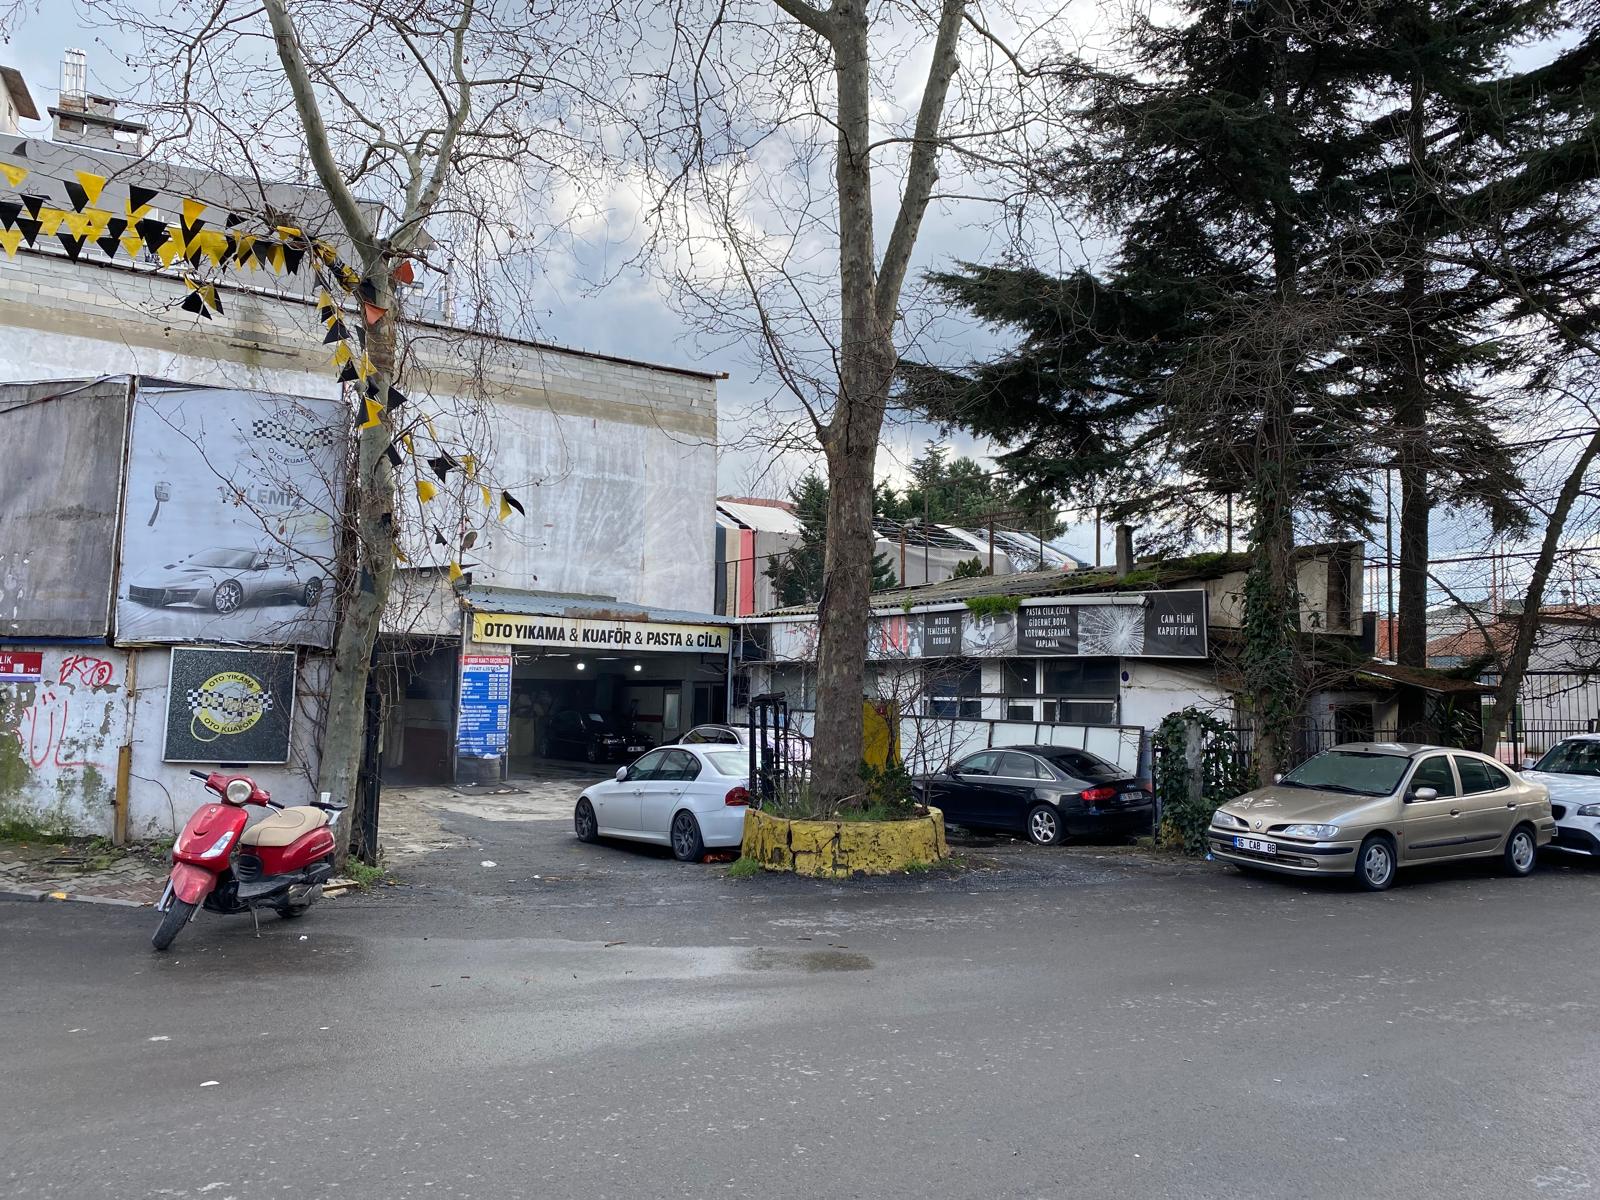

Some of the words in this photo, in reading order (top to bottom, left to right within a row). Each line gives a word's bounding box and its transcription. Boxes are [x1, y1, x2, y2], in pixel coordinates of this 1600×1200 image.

[268, 447, 283, 460] OTO
[1025, 607, 1042, 617] PASTA
[1160, 614, 1175, 624] CAM
[1176, 612, 1195, 624] FİLMİ
[484, 622, 513, 638] OTO
[514, 624, 566, 641] YIKAMA
[569, 627, 579, 642] &
[582, 627, 632, 645] KUAFÖR
[634, 631, 643, 645] &
[646, 631, 683, 647] PASTA
[685, 633, 694, 647] &
[696, 631, 722, 649] CİLA
[1157, 626, 1178, 636] KAPUT
[1179, 624, 1198, 636] FİLMİ
[208, 675, 225, 687] OTO
[226, 674, 255, 689] YIKAMA
[204, 717, 220, 730] OTO
[1249, 841, 1260, 850] CAB
